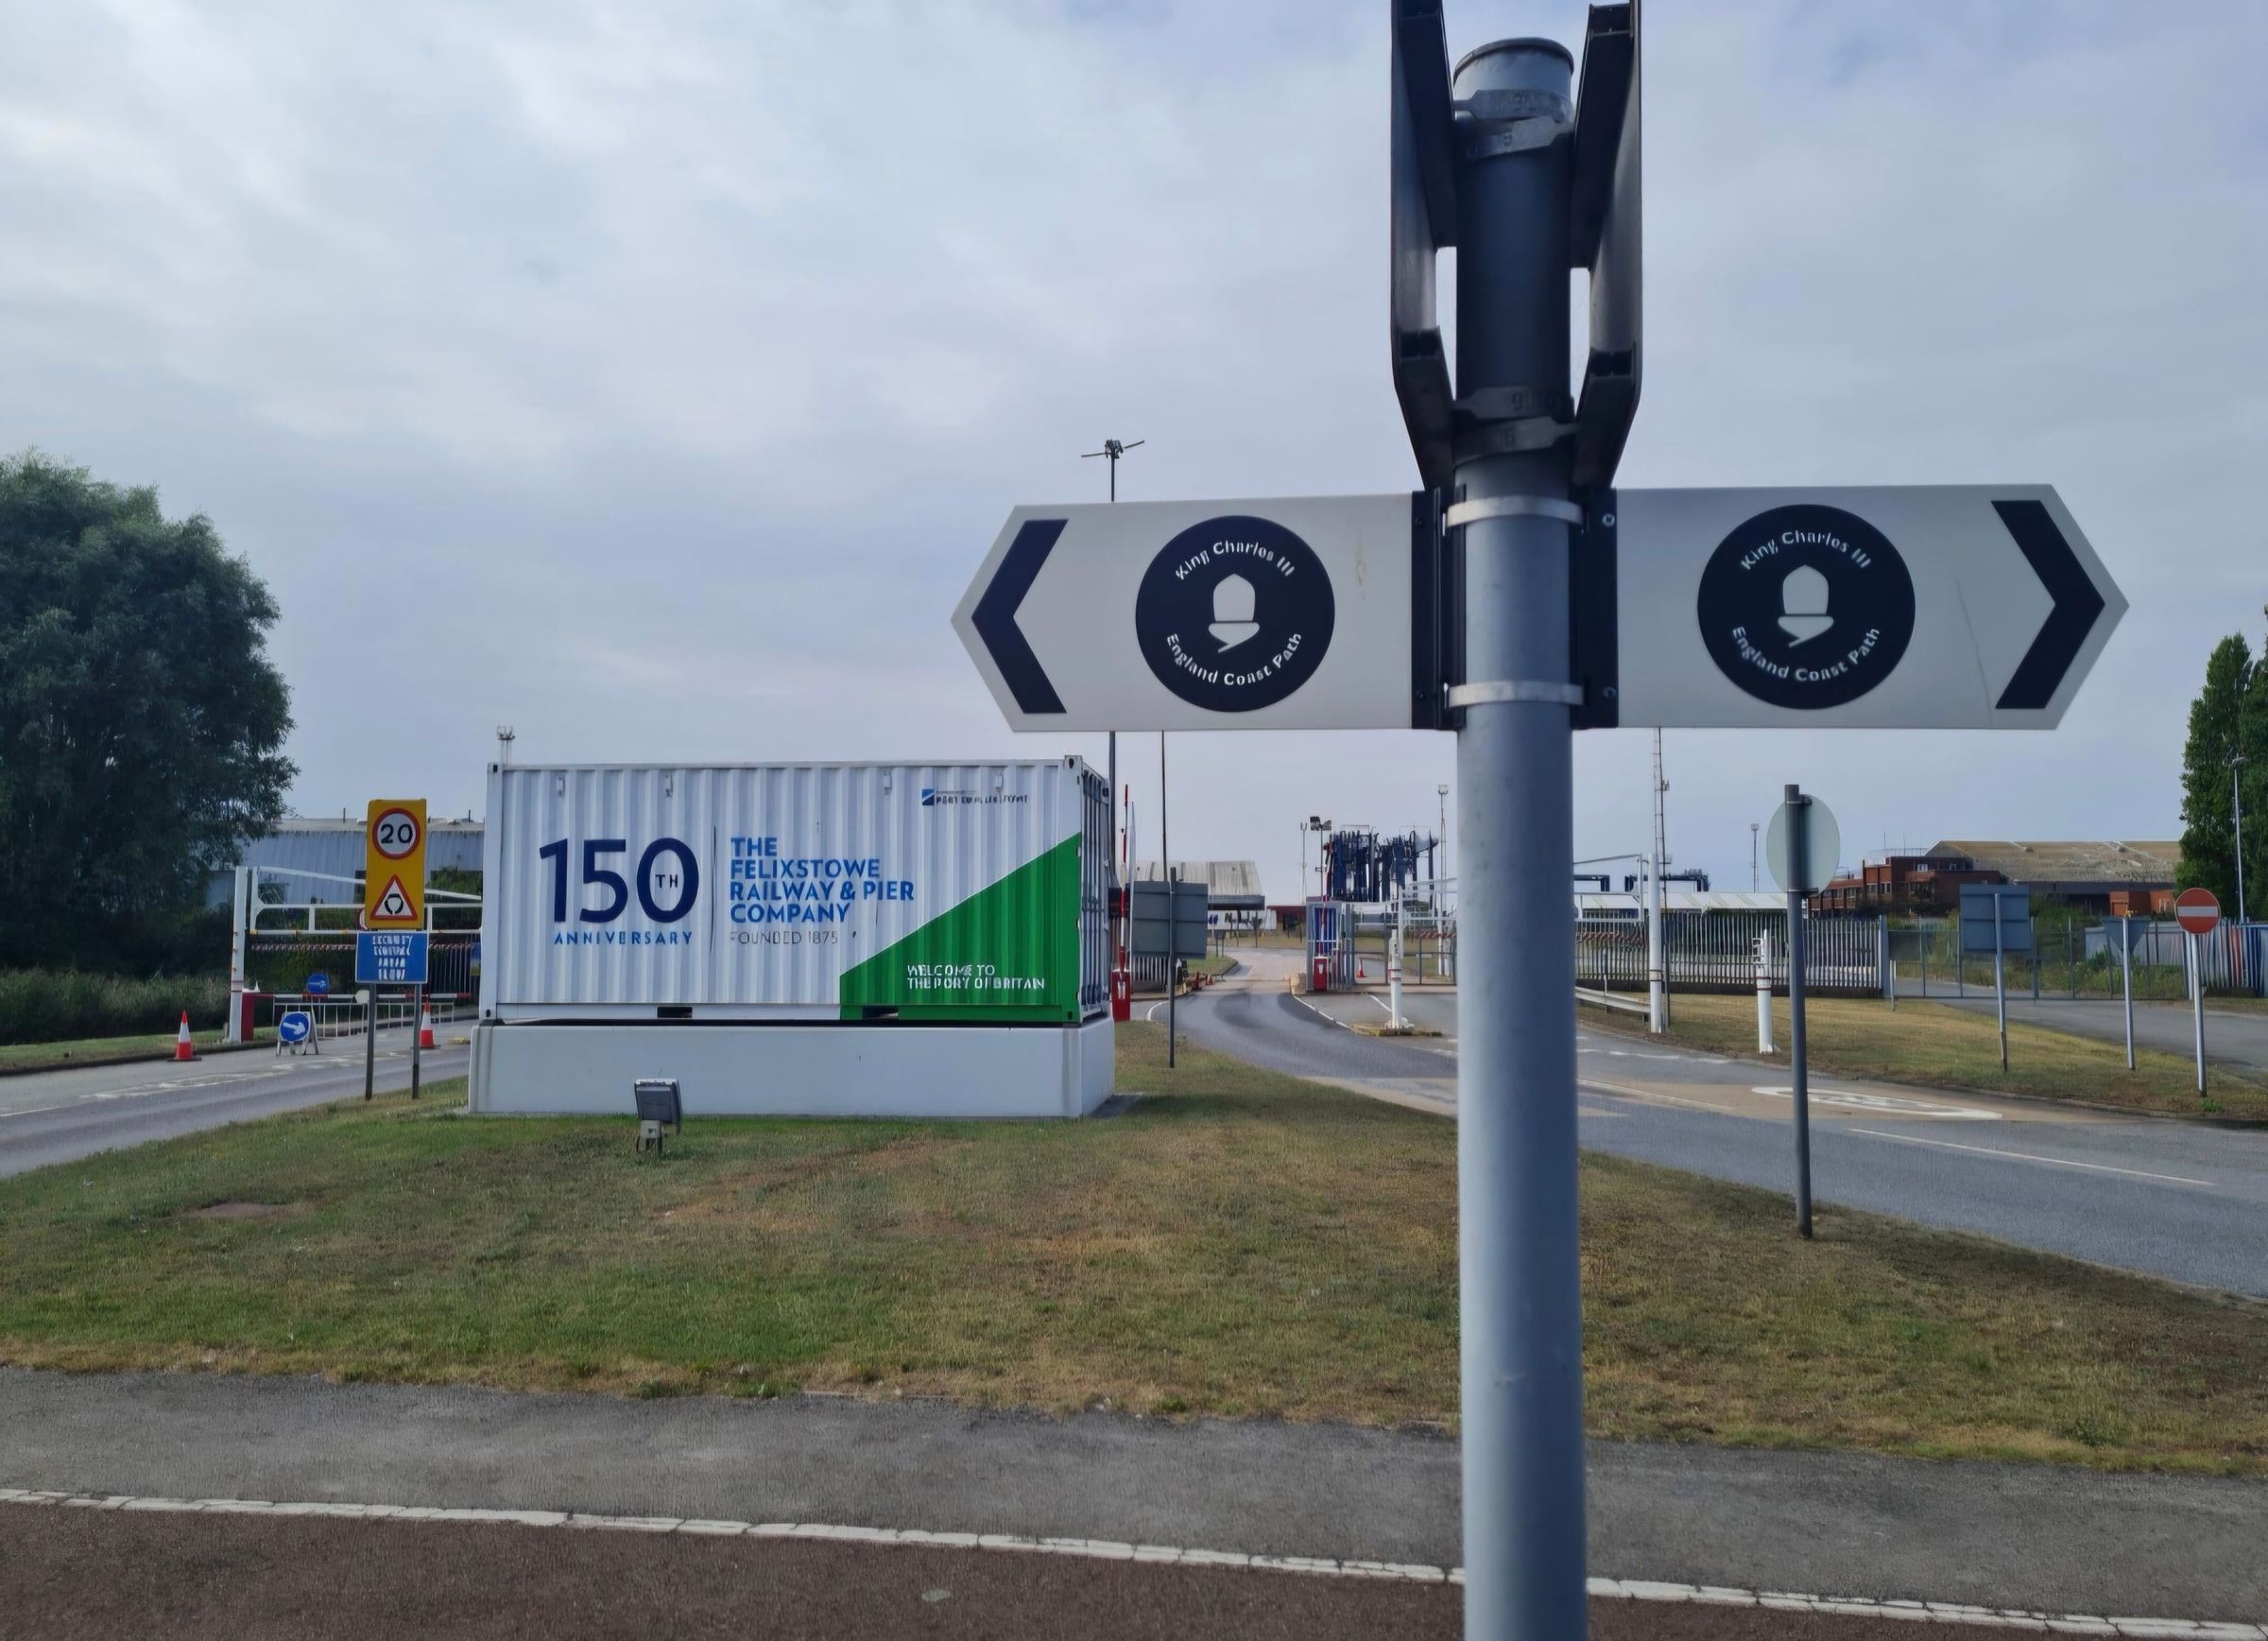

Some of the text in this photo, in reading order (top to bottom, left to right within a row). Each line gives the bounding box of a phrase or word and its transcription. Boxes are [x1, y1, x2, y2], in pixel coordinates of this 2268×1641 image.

[1740, 529, 1872, 570] King Charles III
[1175, 541, 1296, 580] King Charles III
[1166, 632, 1302, 685] England Coast Path
[1731, 626, 1881, 682] England Coast Path
[381, 823, 413, 844] 20
[730, 838, 778, 856] THE
[730, 859, 880, 879] FELIXSTOWE
[540, 838, 699, 924] 150 TH
[730, 881, 914, 901] RAILWAY & PIER
[730, 903, 850, 923] COMPANY
[554, 931, 692, 945] ANNIVERSARY
[730, 931, 801, 944] FOUNDED
[907, 964, 995, 976] WELCOME TO
[907, 977, 931, 989] THE
[993, 977, 1045, 989] BRITAIN
